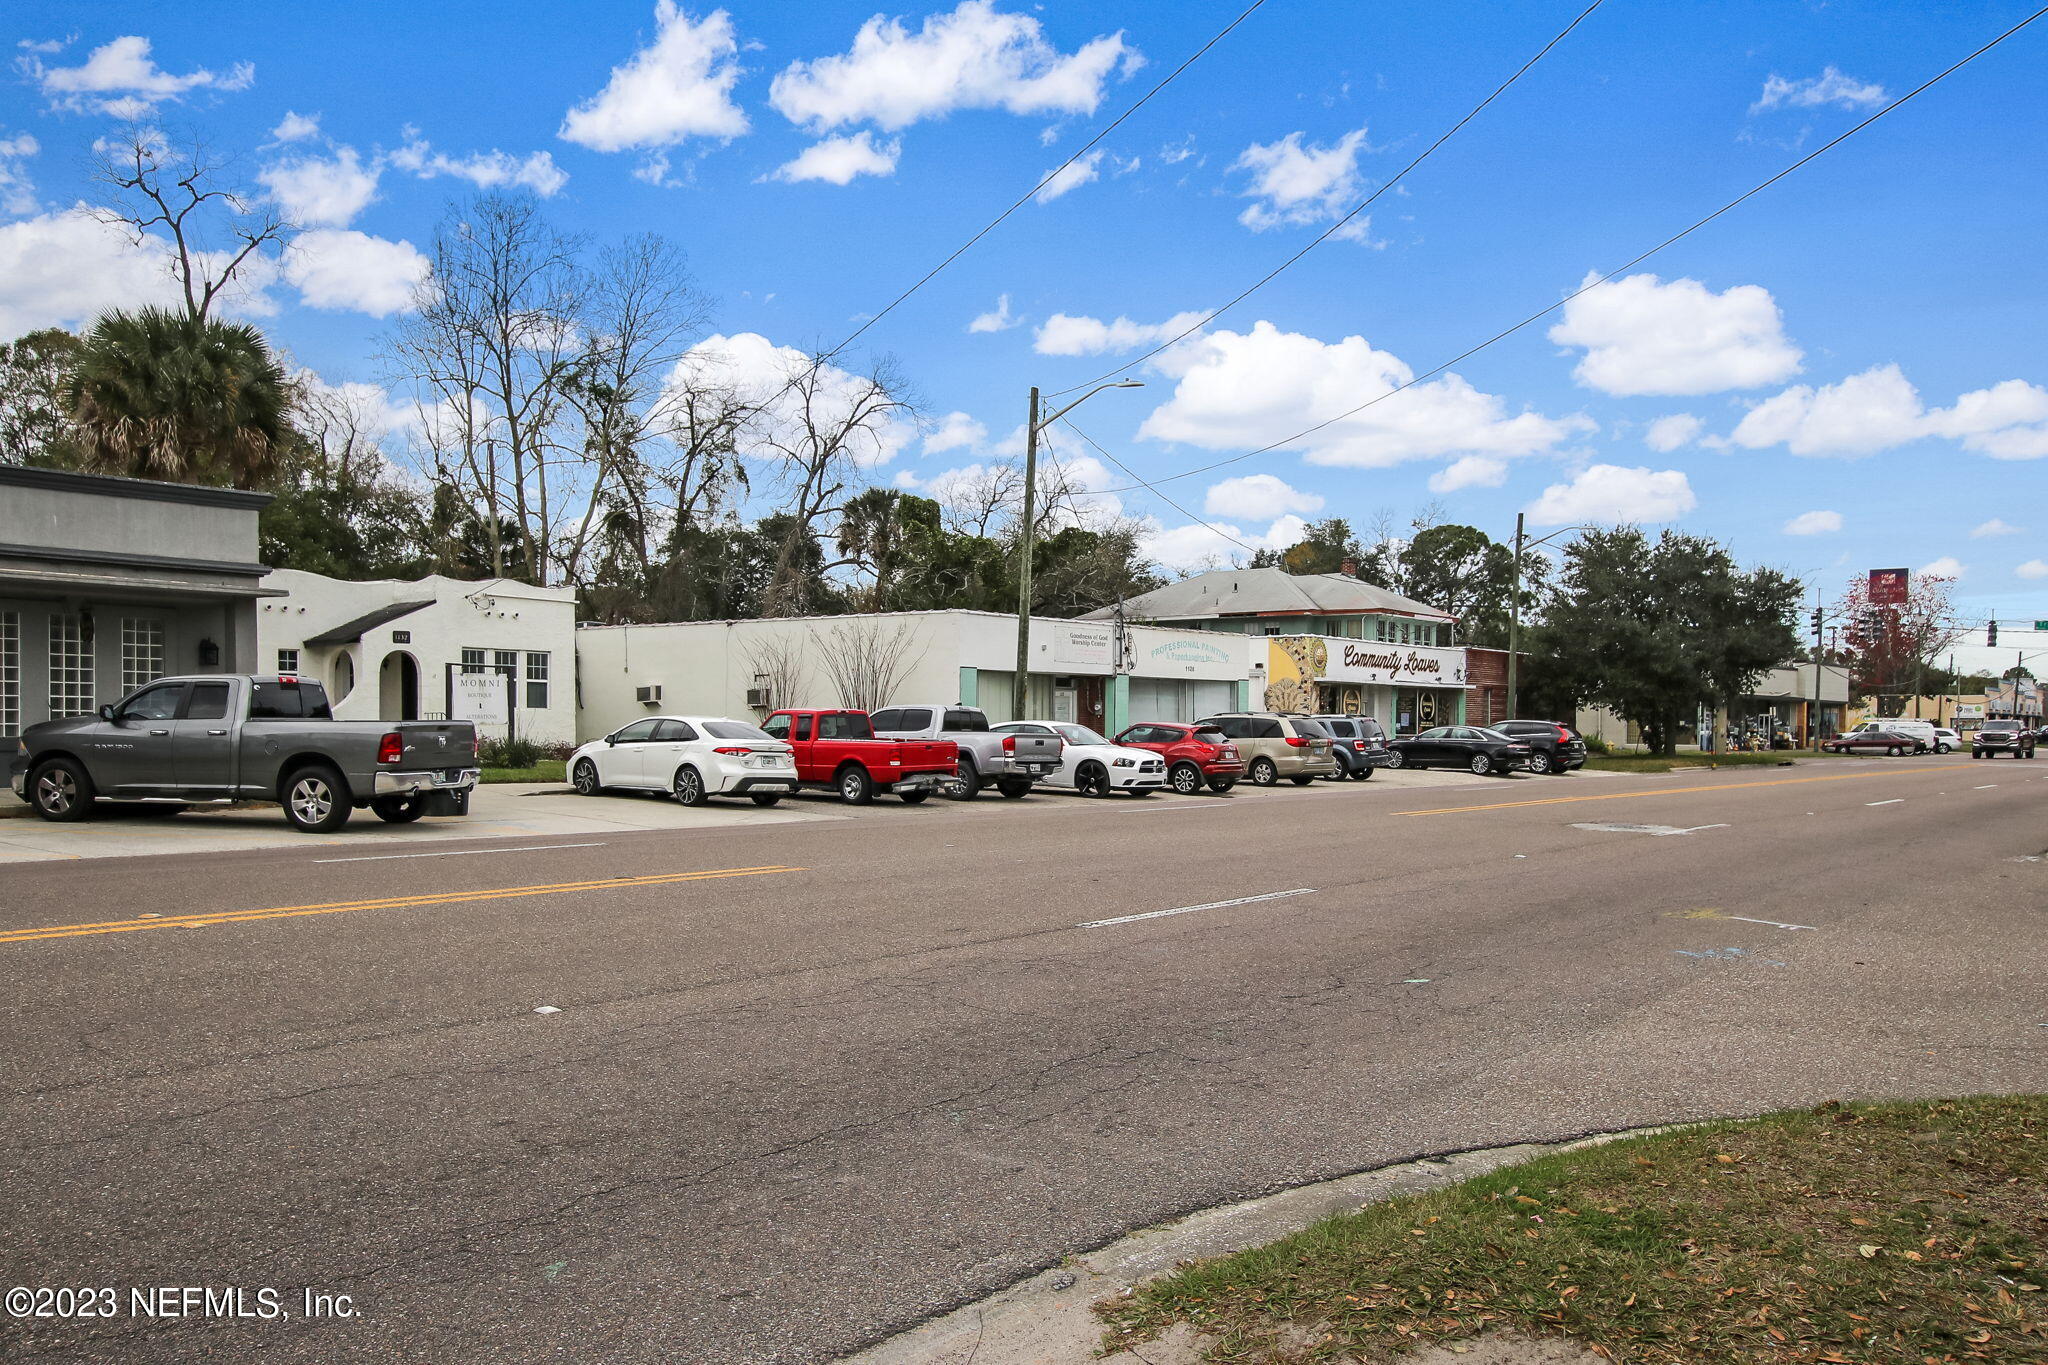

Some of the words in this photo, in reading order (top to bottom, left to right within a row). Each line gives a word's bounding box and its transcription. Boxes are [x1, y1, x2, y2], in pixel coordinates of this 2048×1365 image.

[1072, 639, 1090, 647] Worship
[1151, 641, 1200, 658] PROFESSIONAL
[1201, 642, 1230, 664] PAINTING
[1344, 644, 1402, 679] Community
[1403, 651, 1440, 676] Loaves
[460, 679, 500, 687] MOMNI
